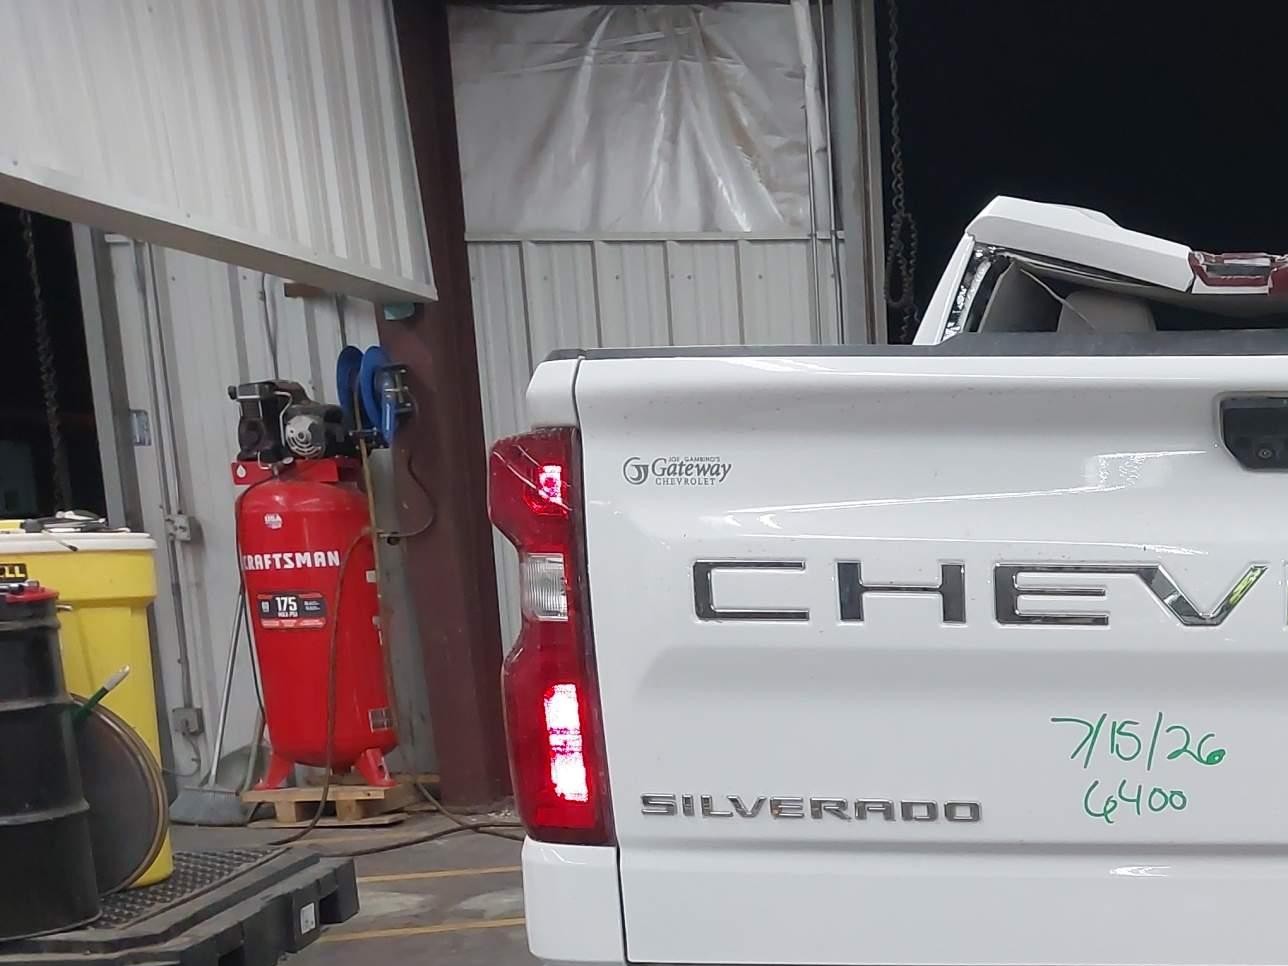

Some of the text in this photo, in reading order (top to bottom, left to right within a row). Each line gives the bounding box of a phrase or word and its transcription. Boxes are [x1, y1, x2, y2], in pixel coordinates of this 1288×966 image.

[651, 457, 732, 482] Gateway
[655, 477, 716, 485] CHEVROLET
[275, 596, 298, 612] 175
[1050, 711, 1226, 771] 7/15/26
[640, 793, 982, 822] SILVERADO
[1083, 778, 1188, 825] 6400
